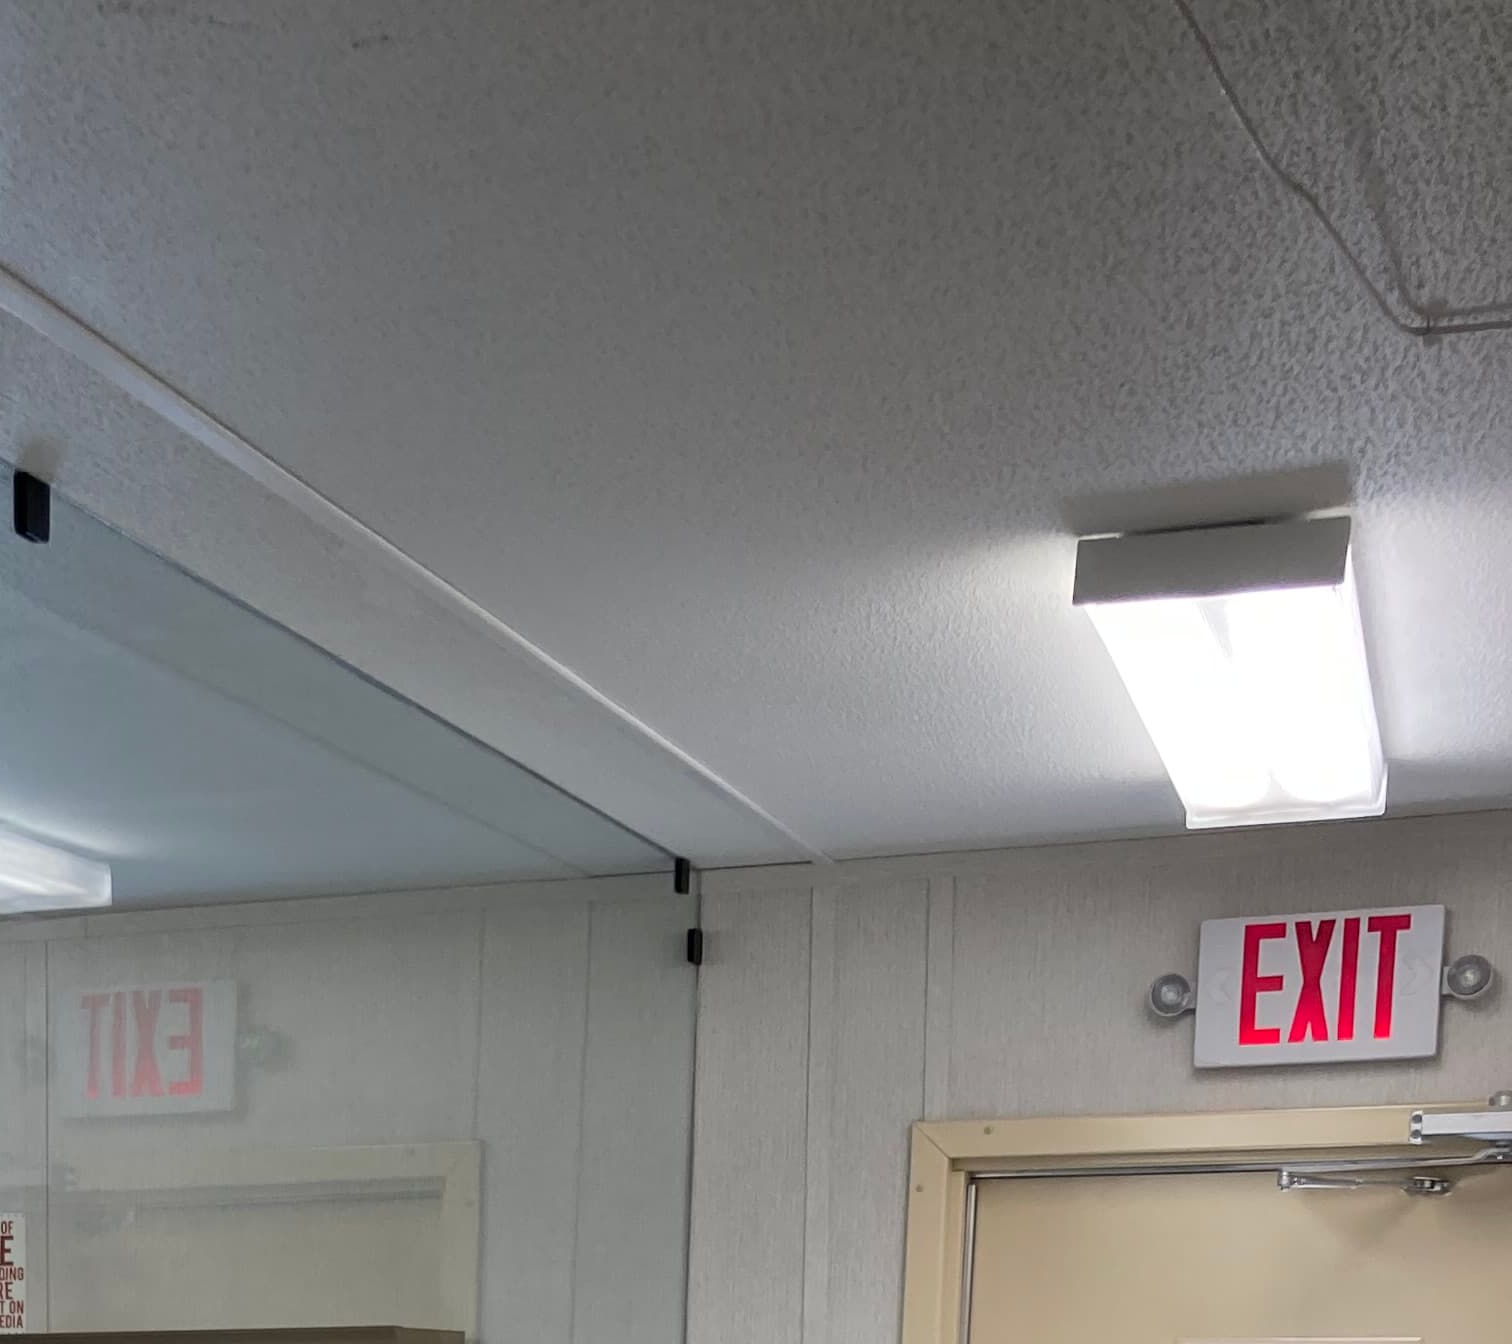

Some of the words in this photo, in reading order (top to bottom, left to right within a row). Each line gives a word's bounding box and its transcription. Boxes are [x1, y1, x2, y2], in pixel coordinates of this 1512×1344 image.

[1238, 914, 1412, 1046] EXIT
[0, 1220, 14, 1233] OF
[9, 1300, 24, 1314] ON
